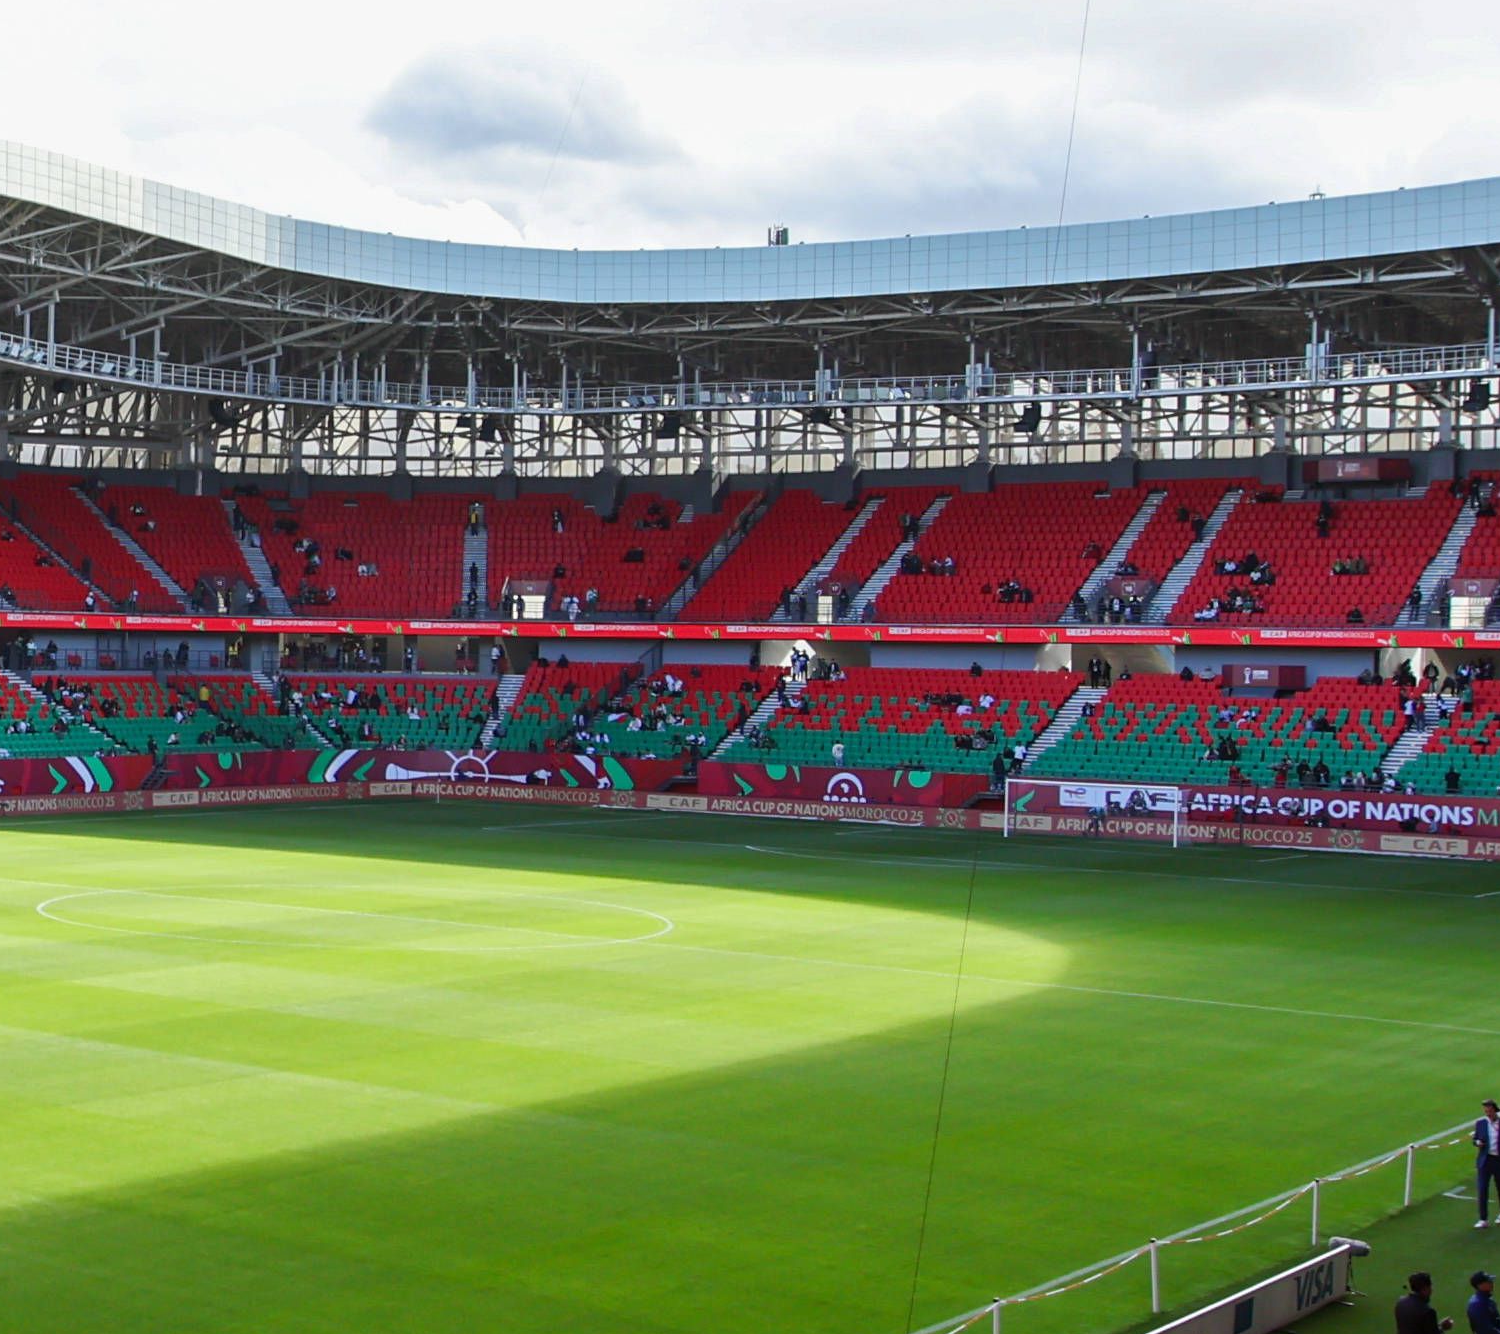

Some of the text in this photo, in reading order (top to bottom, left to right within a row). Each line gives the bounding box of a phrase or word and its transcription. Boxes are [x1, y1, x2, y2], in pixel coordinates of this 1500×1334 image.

[4, 800, 17, 813] OF
[18, 798, 58, 813] NATIONS
[58, 797, 104, 811] MOROCCO
[105, 796, 115, 807] 25
[170, 793, 194, 804] CAF
[200, 790, 230, 803] AFRICA
[231, 789, 246, 802] CUP
[247, 789, 257, 800] OF
[258, 787, 292, 800] NATIONS
[291, 786, 331, 798] MOROCCO
[384, 784, 405, 793] CAF
[455, 785, 474, 798] CUP
[475, 786, 489, 798] OF
[490, 786, 534, 800] NATIONS
[533, 788, 588, 802] MOROCCO
[589, 791, 600, 803] 25
[669, 797, 924, 822] CAF AFRICA CUP OF NATIONS MOROCCO 25
[1190, 792, 1275, 815] AFRICA
[1277, 796, 1325, 817] CUP
[1327, 799, 1362, 819] OF
[1365, 801, 1474, 826] NATIONS
[1106, 819, 1132, 834] CUP
[1135, 821, 1154, 835] OF
[1156, 822, 1217, 839] NATIONS
[1297, 830, 1313, 844] 25
[1412, 838, 1459, 852] CAF
[1294, 1261, 1334, 1311] VISA
